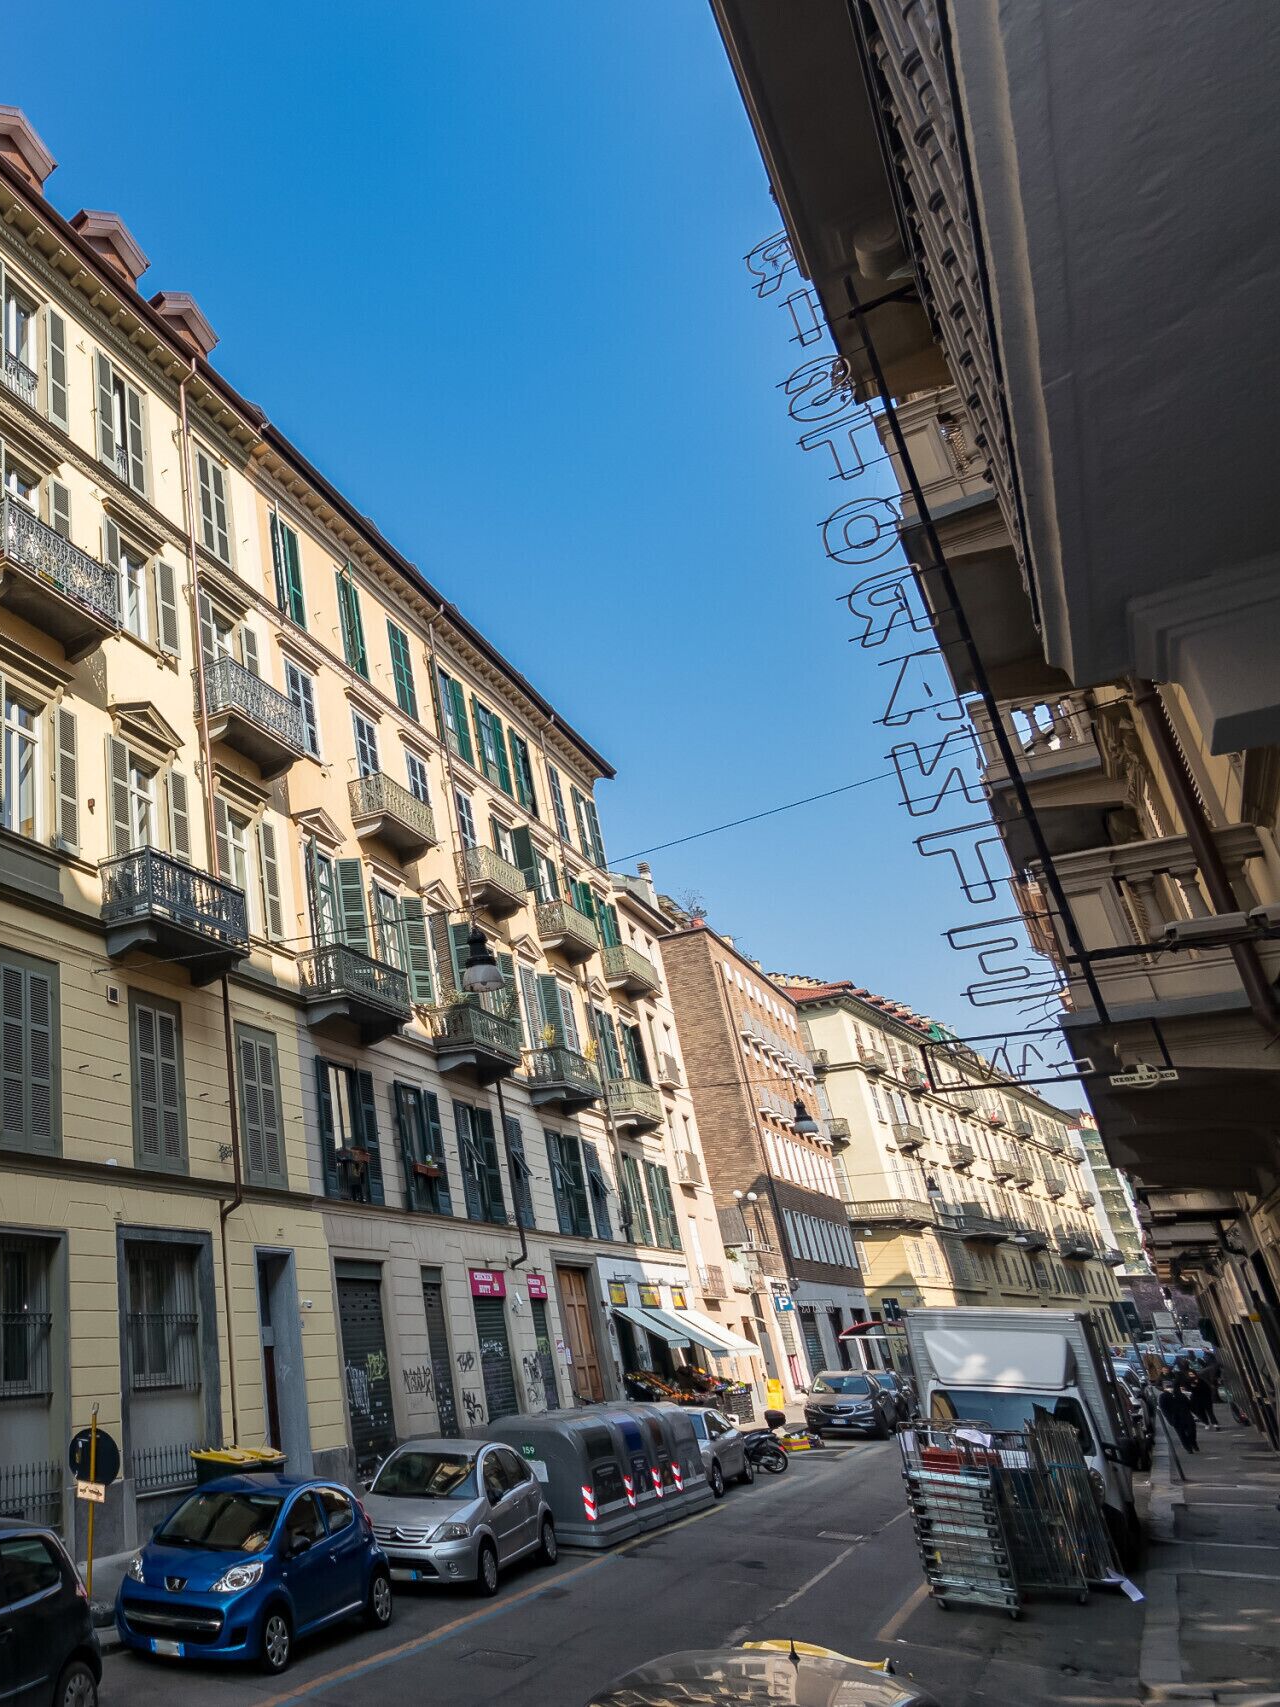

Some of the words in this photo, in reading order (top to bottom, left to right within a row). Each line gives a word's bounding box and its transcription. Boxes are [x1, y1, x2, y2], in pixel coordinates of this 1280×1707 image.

[1113, 1075, 1136, 1083] NEON
[778, 1298, 791, 1310] P
[522, 1446, 535, 1454] 159
